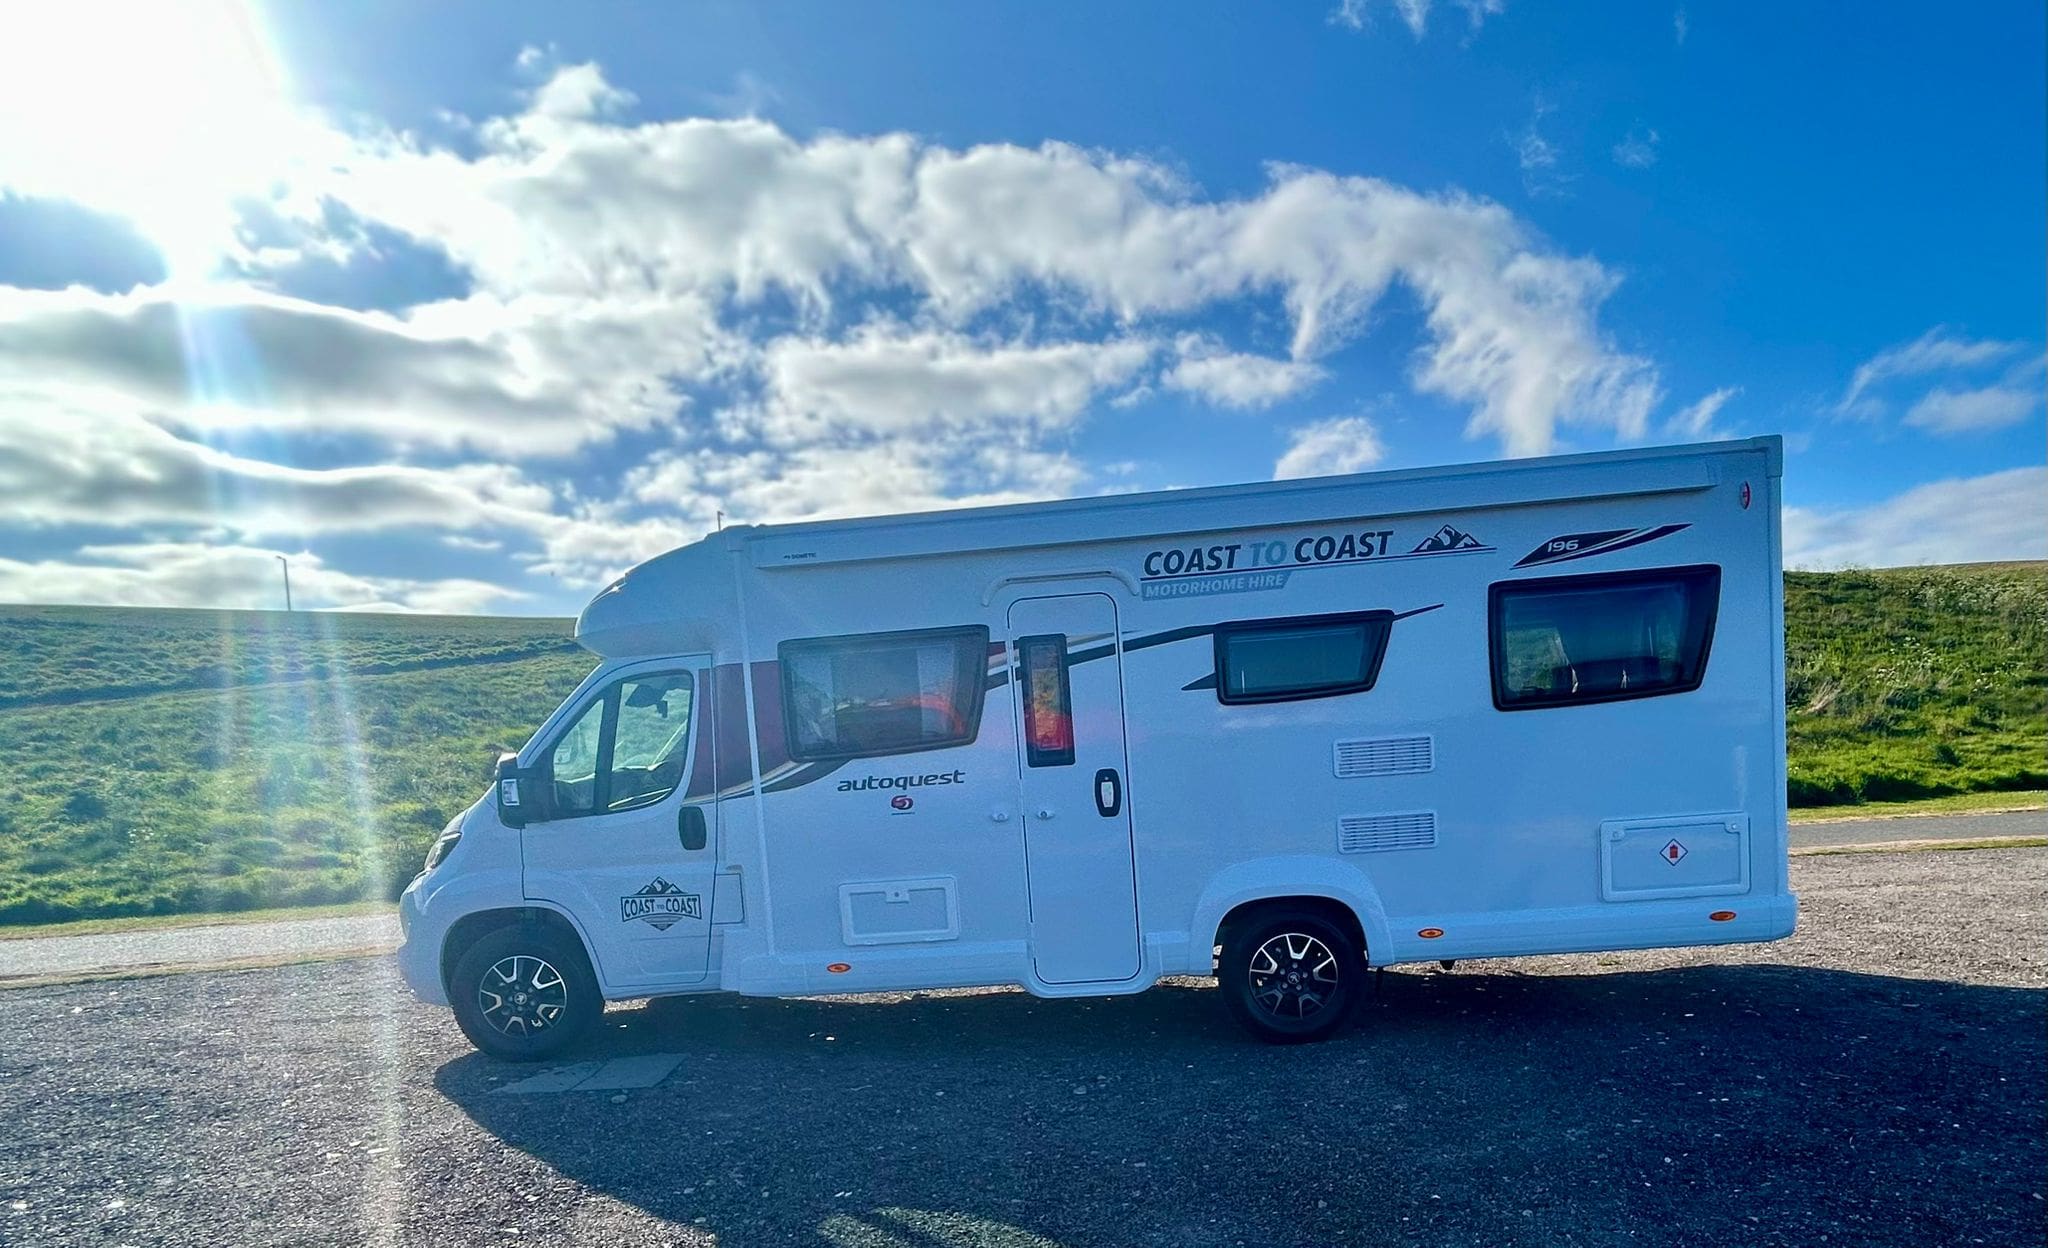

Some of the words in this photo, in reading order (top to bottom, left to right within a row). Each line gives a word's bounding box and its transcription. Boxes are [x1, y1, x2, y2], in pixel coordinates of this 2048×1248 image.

[1144, 544, 1241, 576] COAST
[1249, 540, 1287, 567] TO
[1294, 530, 1394, 563] COAST
[1547, 540, 1579, 553] 196
[1145, 577, 1245, 598] MOTORHOME
[1248, 573, 1284, 590] HIRE
[837, 769, 966, 792] autoquest
[624, 899, 655, 917] COAST
[666, 898, 698, 915] COAST
